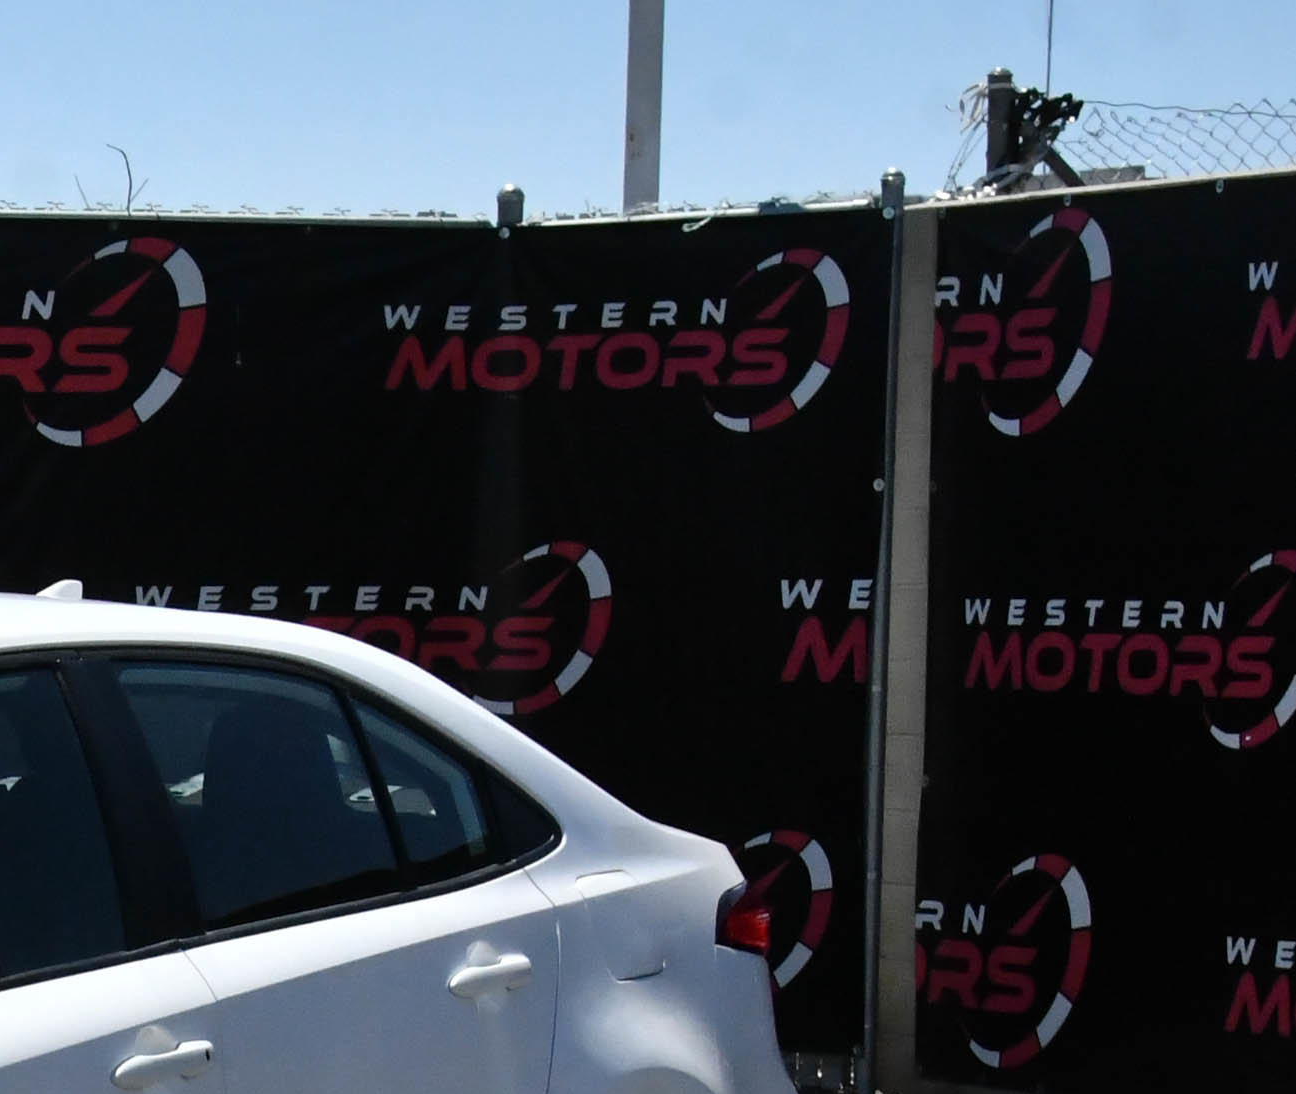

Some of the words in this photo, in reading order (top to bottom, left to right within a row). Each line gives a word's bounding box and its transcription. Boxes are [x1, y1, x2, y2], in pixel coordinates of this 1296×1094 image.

[386, 300, 727, 330] WESTERN
[389, 330, 788, 391] MOTORS
[135, 586, 488, 611] WESTERN
[967, 601, 1224, 629] WESTERN
[968, 633, 1274, 698] MOTORS
